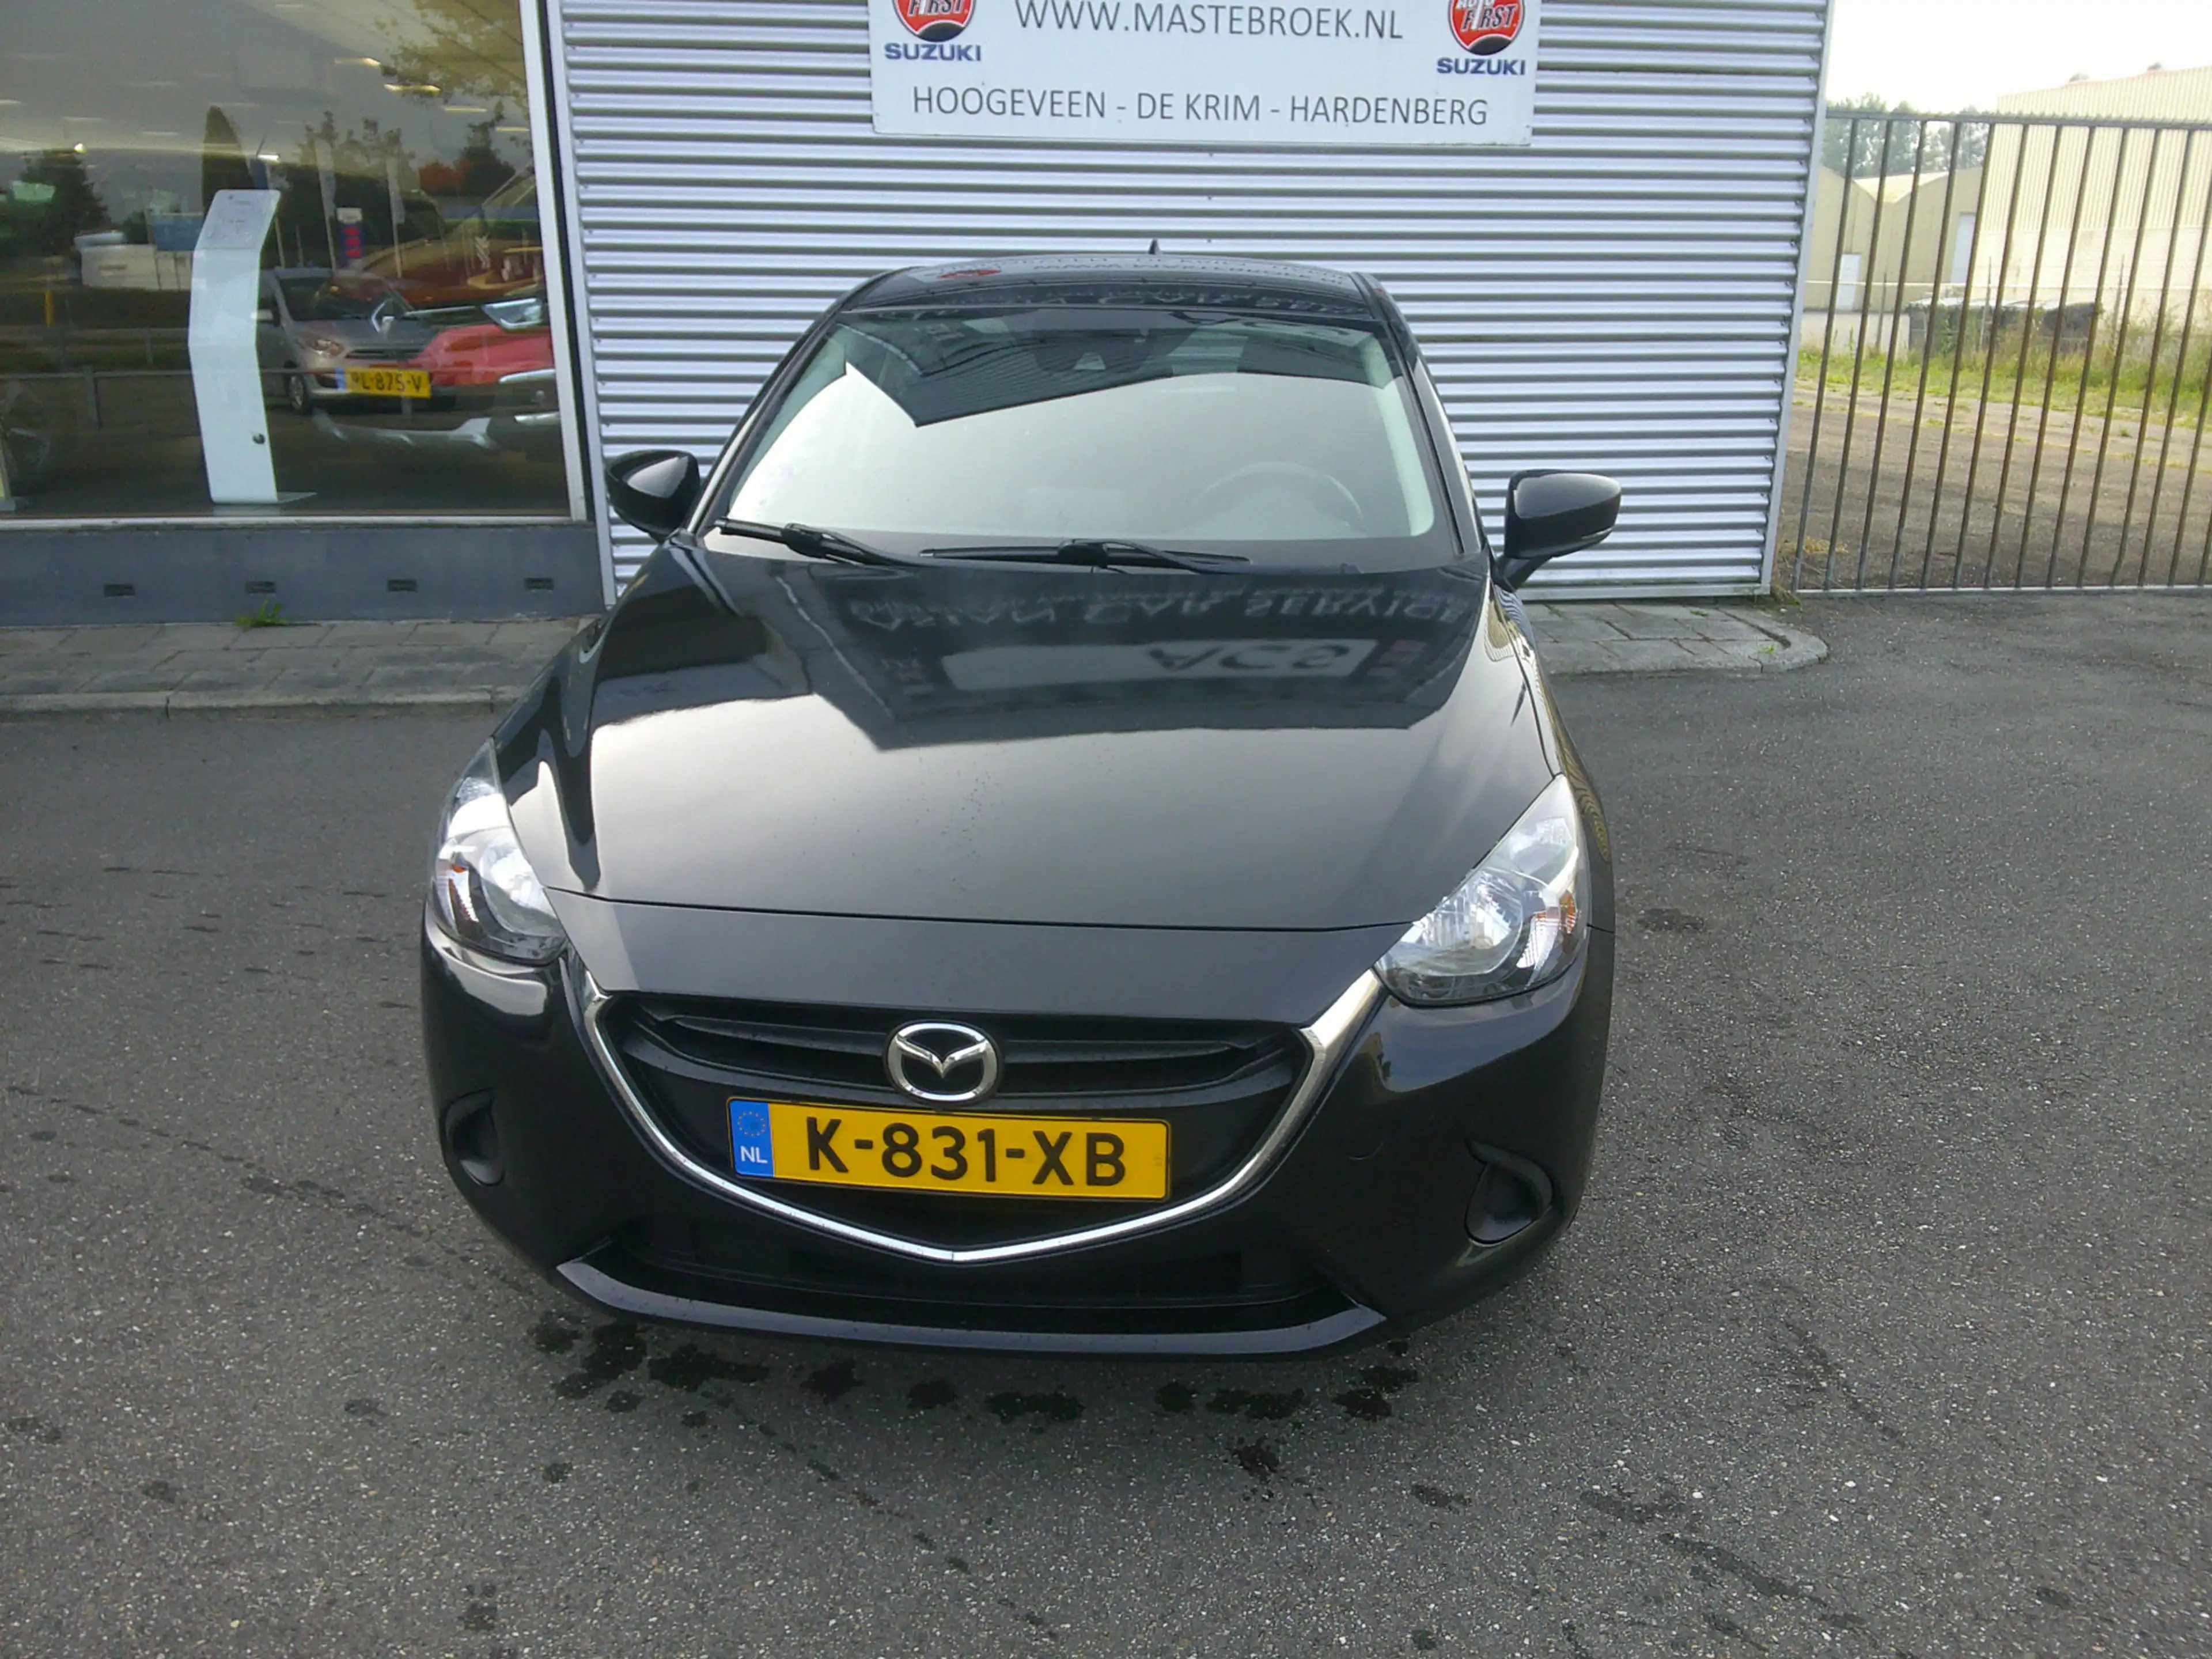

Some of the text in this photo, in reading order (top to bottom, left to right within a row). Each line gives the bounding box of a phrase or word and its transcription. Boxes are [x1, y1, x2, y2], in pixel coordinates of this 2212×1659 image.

[1016, 0, 1403, 39] WWW.MASTEBROEK.NL
[1461, 4, 1518, 31] FIRST
[884, 43, 982, 62] SUZUKI
[1437, 56, 1526, 75] SUZUKI
[914, 86, 1105, 119] HOOGEVEEN
[1138, 92, 1173, 119] DE
[1186, 93, 1260, 122] KRIM
[1290, 95, 1488, 125] HARDENBERG
[740, 1145, 768, 1164] NL
[806, 1116, 1126, 1188] K-831-XB
